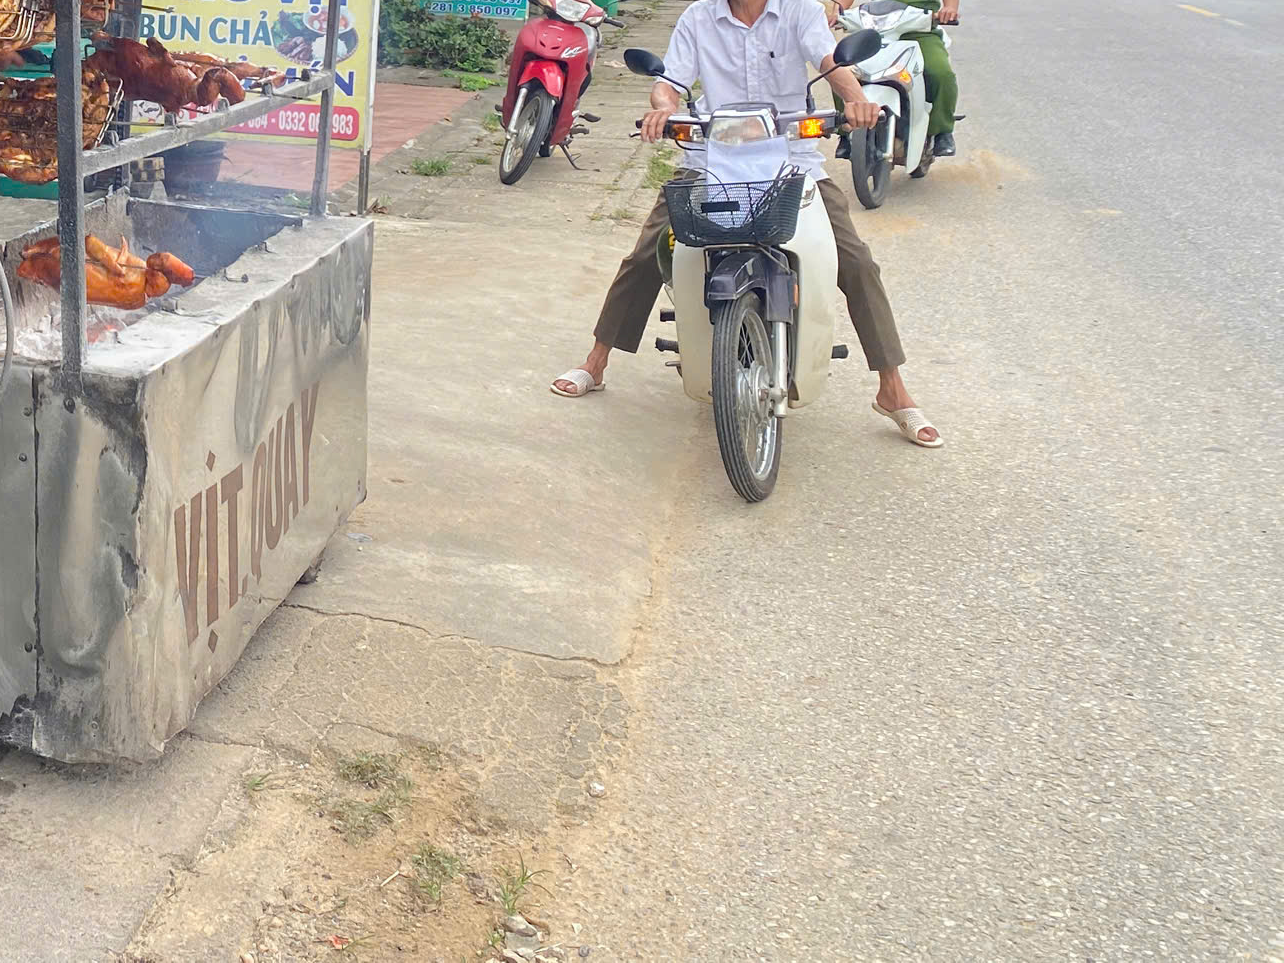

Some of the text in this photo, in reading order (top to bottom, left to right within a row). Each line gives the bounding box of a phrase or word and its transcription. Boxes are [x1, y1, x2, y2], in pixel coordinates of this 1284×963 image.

[458, 4, 465, 13] 3
[495, 6, 519, 17] 097
[208, 10, 273, 46] CHẢ
[278, 110, 305, 130] 0332
[332, 113, 354, 135] 983
